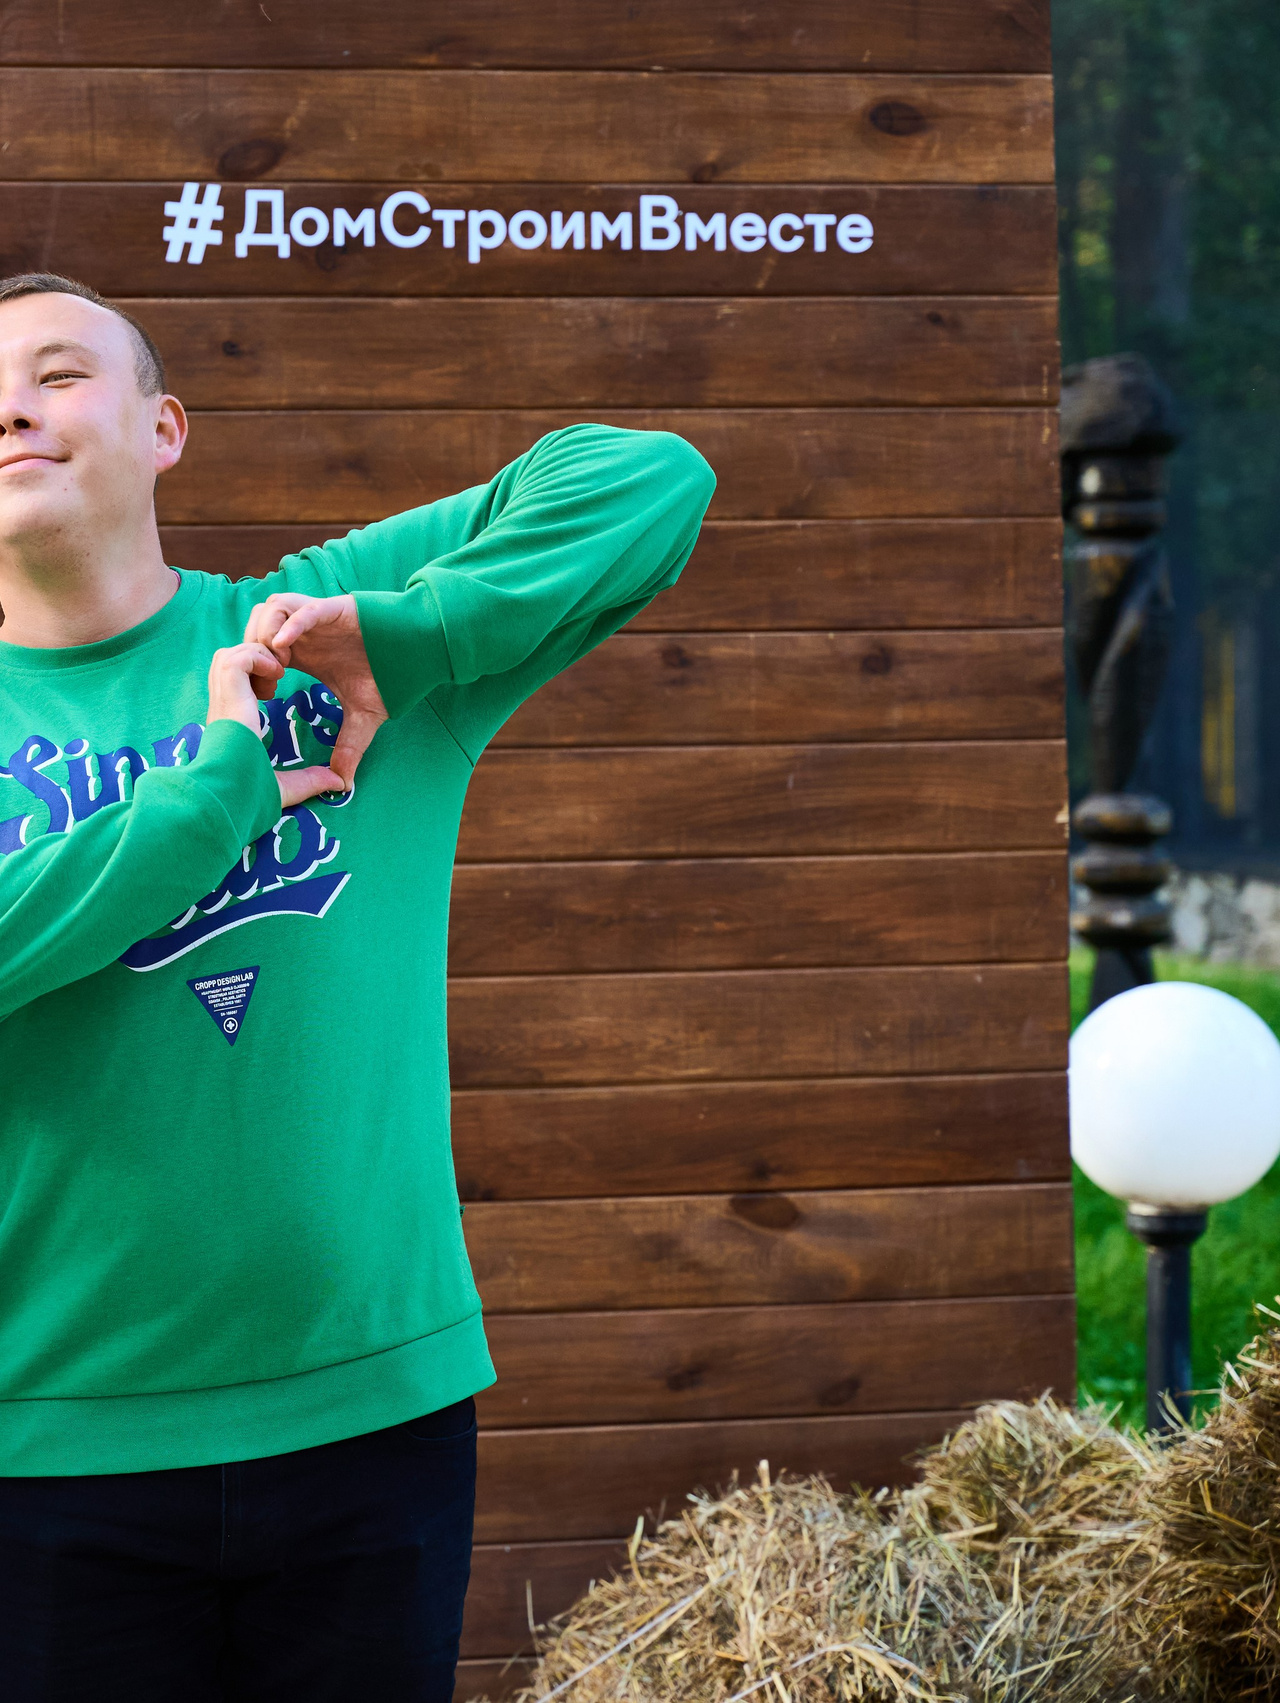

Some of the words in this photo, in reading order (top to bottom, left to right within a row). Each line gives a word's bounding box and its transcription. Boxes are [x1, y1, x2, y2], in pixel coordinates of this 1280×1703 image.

[162, 181, 874, 265] #ДомСтроимВместе
[195, 980, 217, 990] CROPP
[217, 975, 240, 986] DESIGN
[241, 972, 253, 981] LAB
